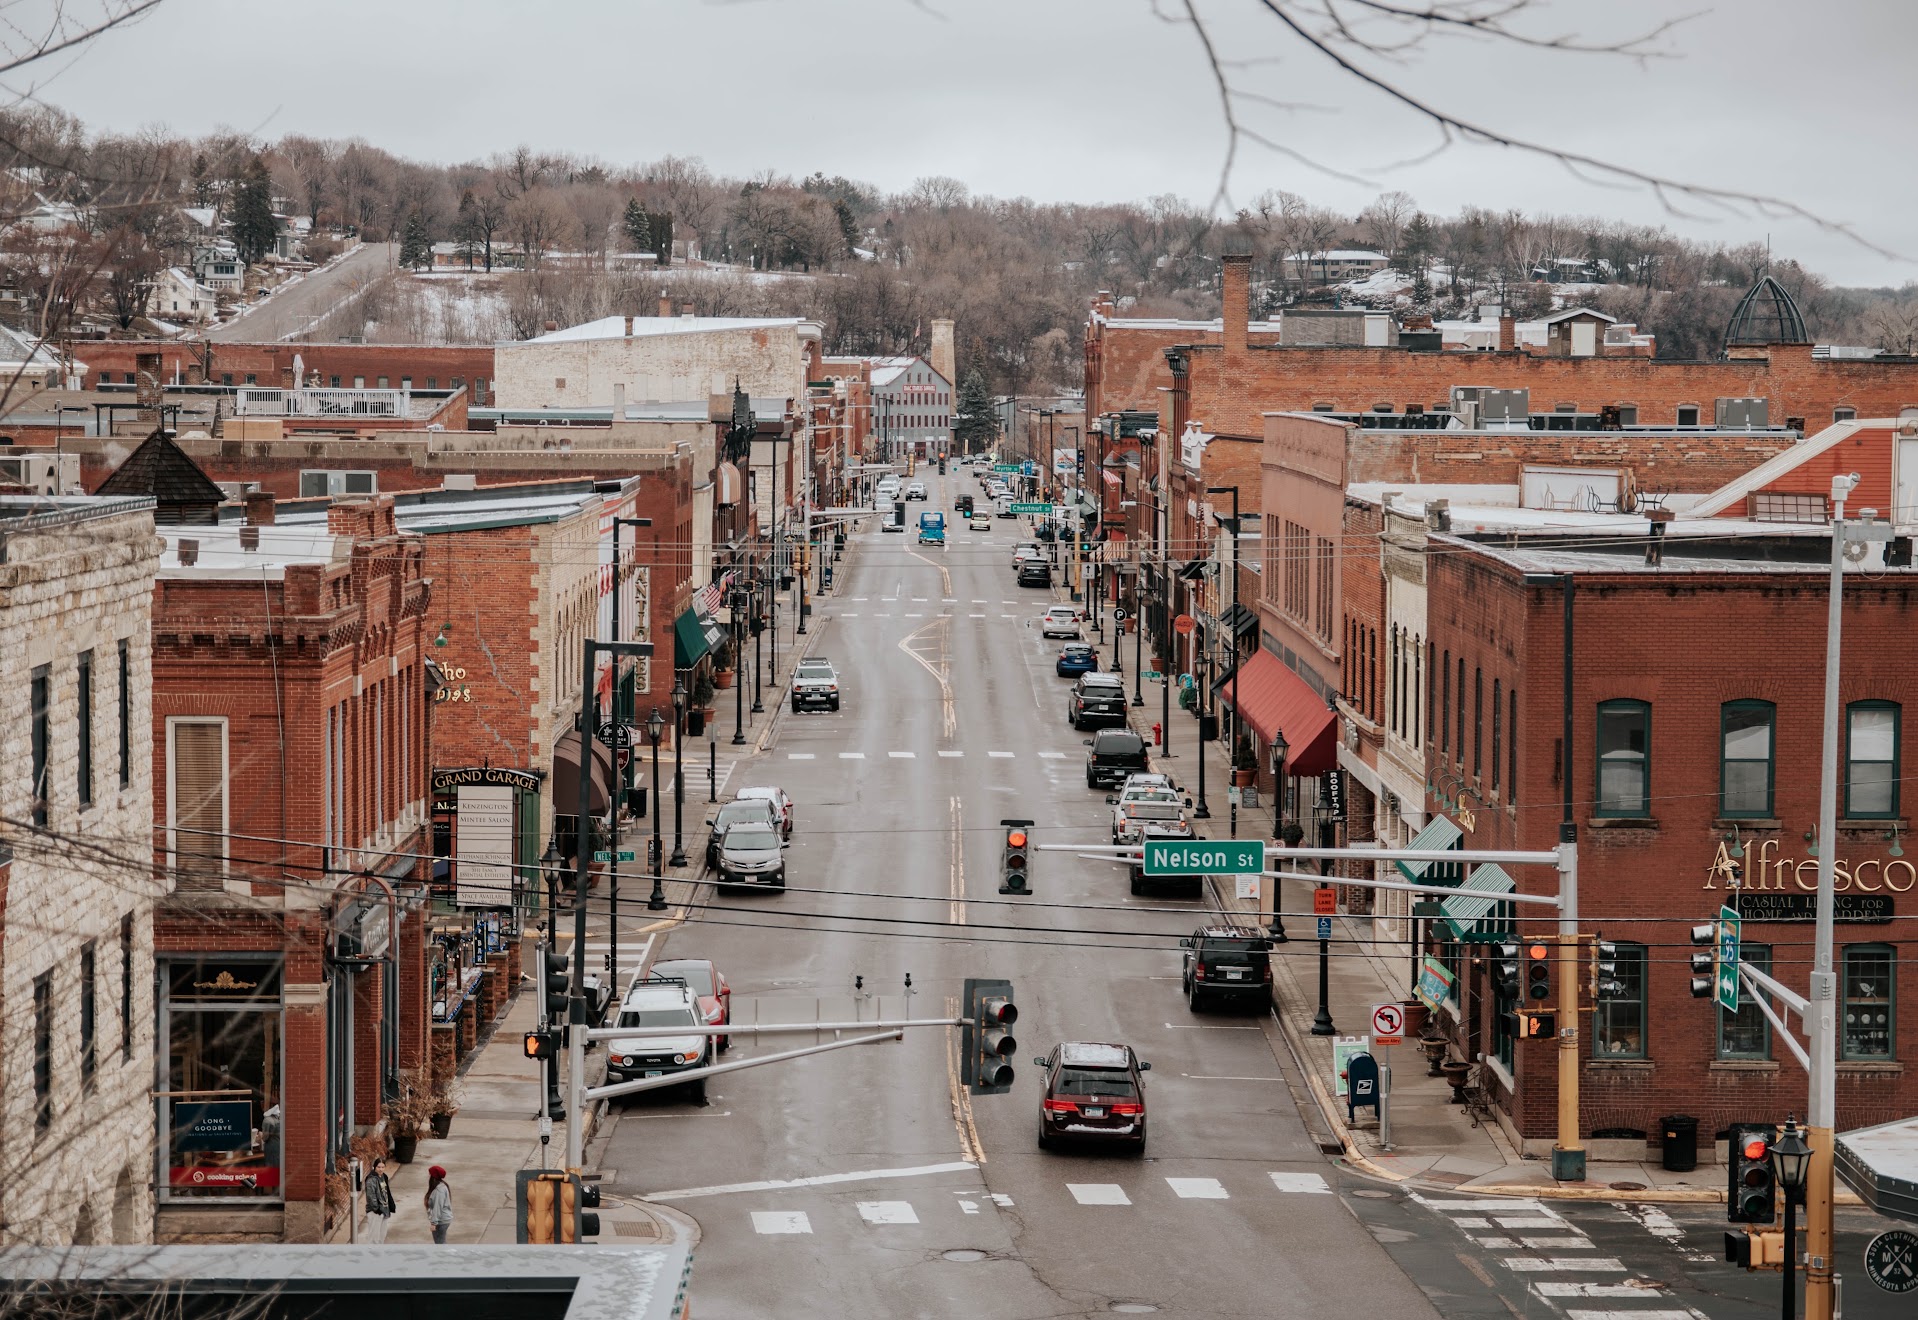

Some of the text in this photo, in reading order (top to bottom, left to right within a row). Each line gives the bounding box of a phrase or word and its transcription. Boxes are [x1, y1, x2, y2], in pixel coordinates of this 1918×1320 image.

[635, 569, 647, 691] ANTIQES
[434, 770, 536, 790] GRAND GARAGE
[597, 852, 621, 861] NELSN
[1154, 849, 1254, 867] Nelson St
[1703, 839, 1917, 892] Alfresco
[1741, 896, 1884, 909] CASUAL LING FOR
[1744, 909, 1783, 921] HOME
[1829, 909, 1881, 922] ARDEN
[207, 1173, 257, 1182] cooking schol
[1869, 1232, 1918, 1257] SOTA CLOTHING
[1882, 1252, 1912, 1263] M N
[1868, 1265, 1899, 1291] MINNESOTA
[1893, 1267, 1901, 1275] 32
